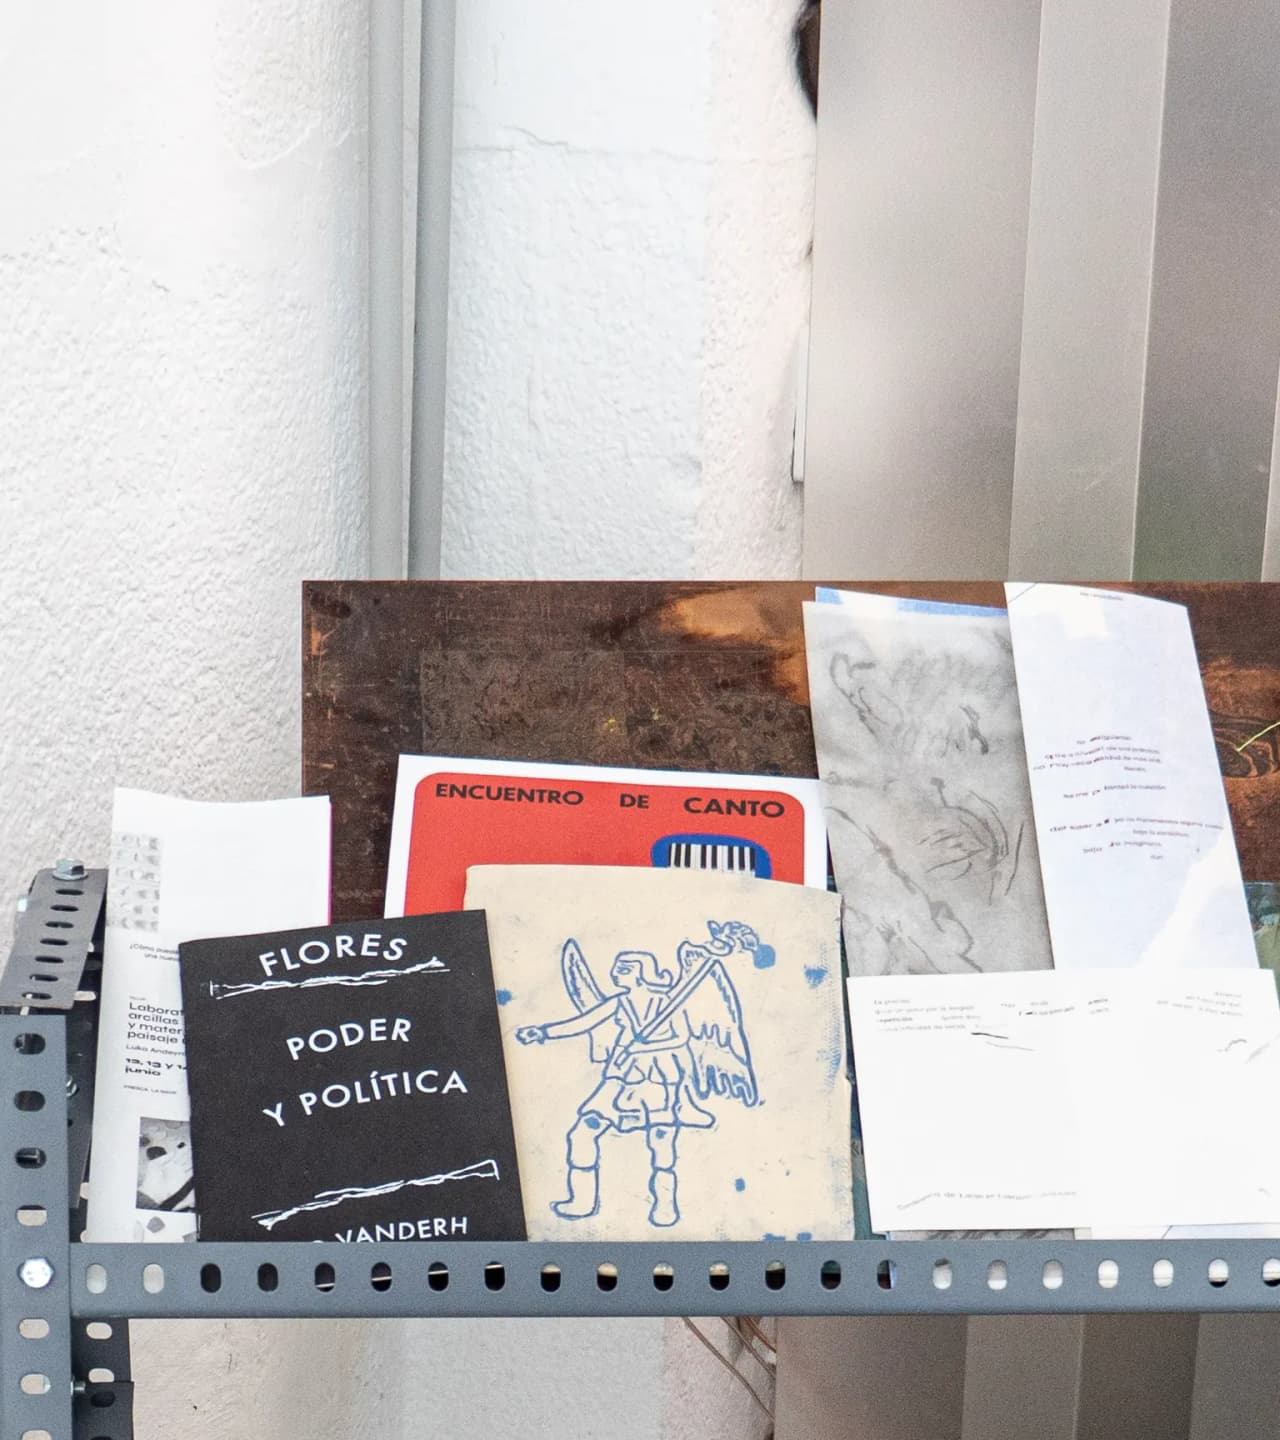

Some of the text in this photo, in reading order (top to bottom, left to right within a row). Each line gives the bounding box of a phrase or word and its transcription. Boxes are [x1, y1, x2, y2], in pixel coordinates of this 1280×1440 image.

[435, 783, 785, 818] ENCUENTRO DE CANTO
[259, 934, 407, 976] FLORES
[128, 1012, 179, 1025] arcillas
[129, 1002, 184, 1016] Laborat
[128, 1031, 179, 1045] paisaje
[139, 1024, 184, 1036] mater
[286, 1018, 411, 1060] PODER
[125, 1065, 161, 1077] junio
[262, 1070, 468, 1127] Y POLÍTICA
[335, 1217, 467, 1243] VANDERH
